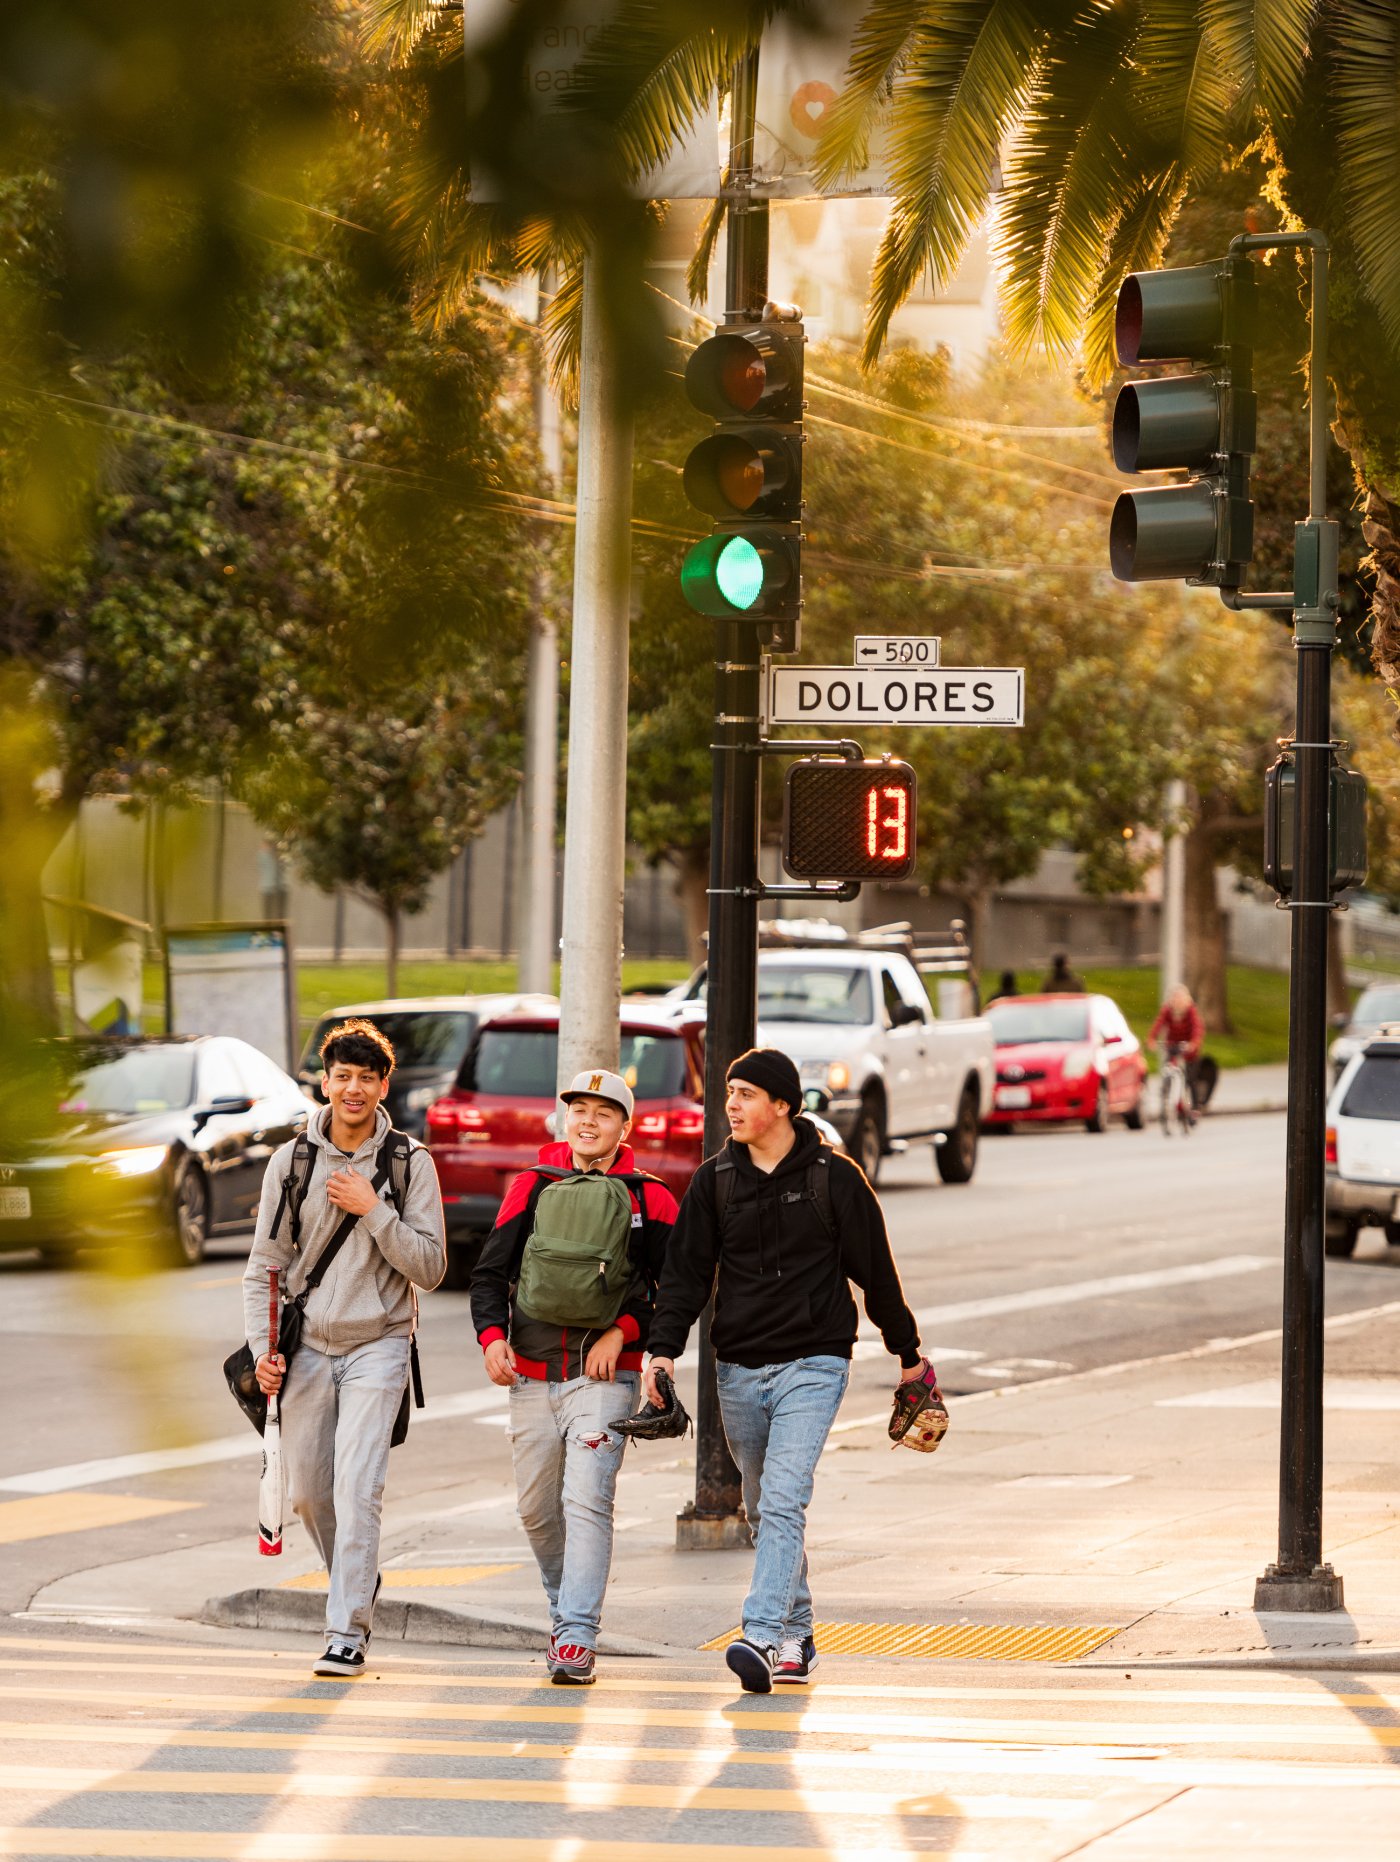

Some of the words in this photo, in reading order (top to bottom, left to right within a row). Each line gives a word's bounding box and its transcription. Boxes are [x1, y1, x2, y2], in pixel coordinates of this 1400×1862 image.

[886, 642, 929, 662] 500
[799, 681, 995, 712] DOLORES
[867, 786, 906, 858] 13
[588, 1074, 604, 1091] M
